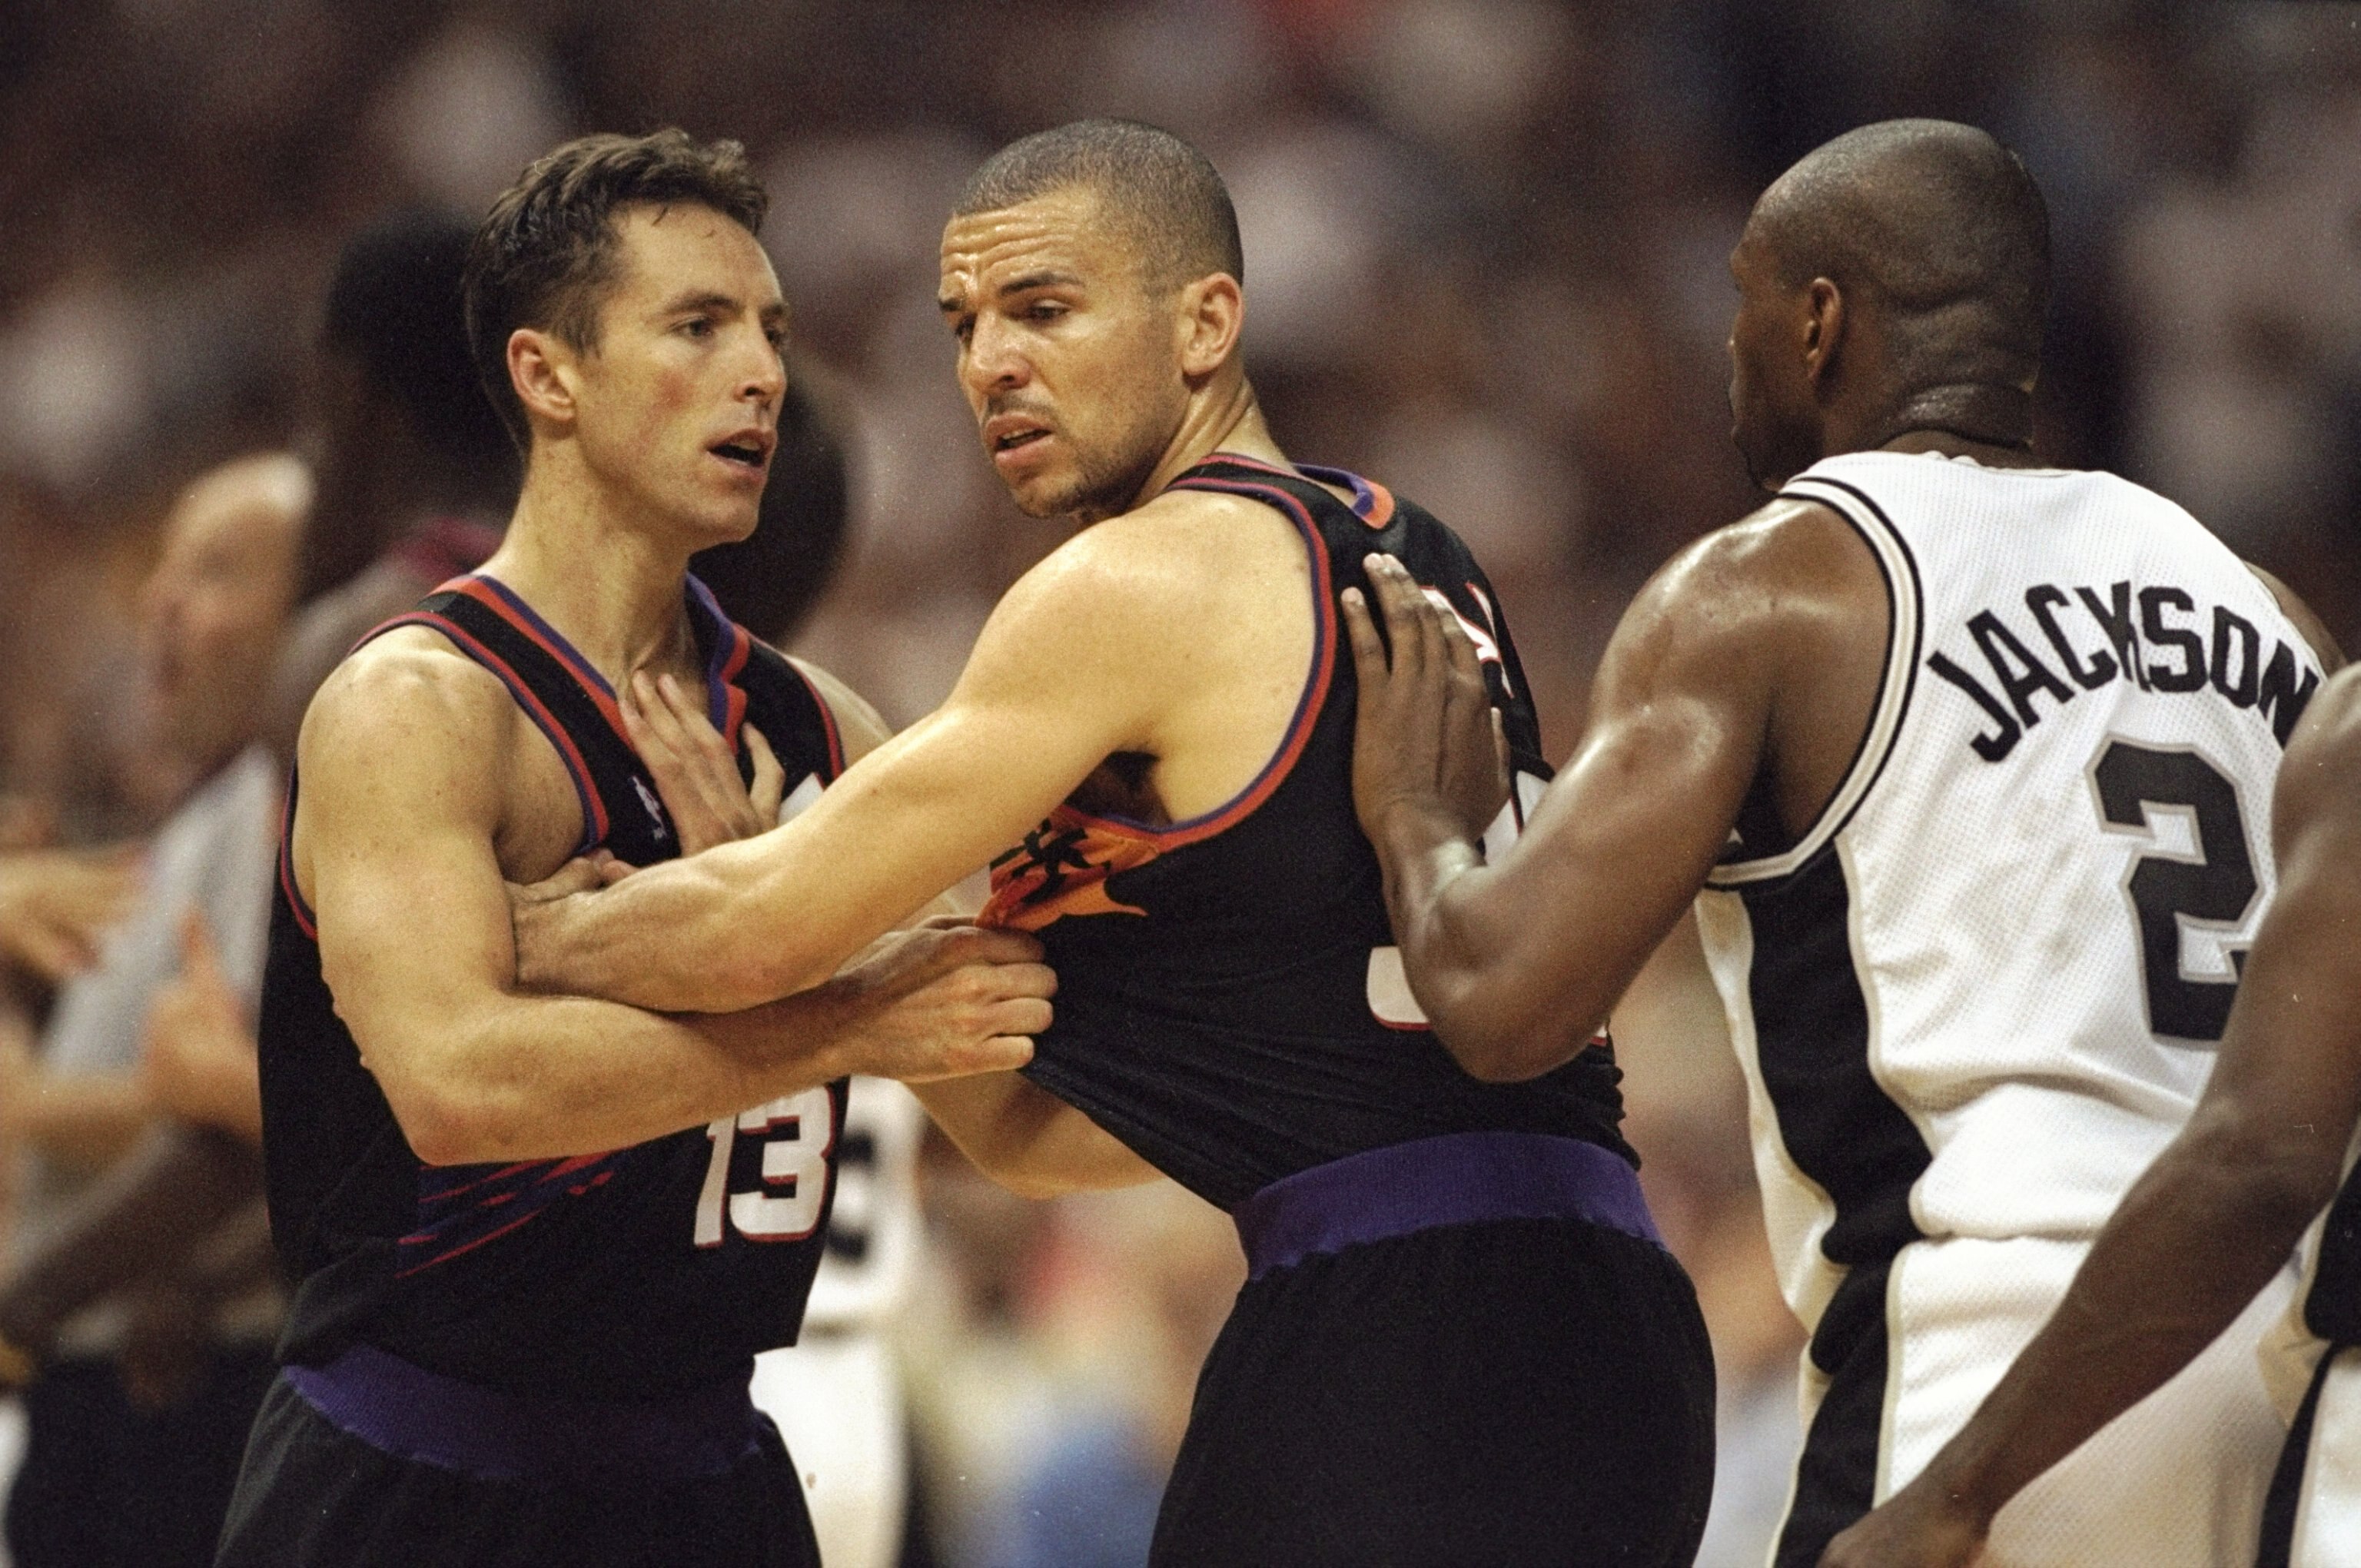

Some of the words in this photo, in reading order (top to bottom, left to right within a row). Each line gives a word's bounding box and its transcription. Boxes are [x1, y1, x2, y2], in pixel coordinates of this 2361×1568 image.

[1925, 580, 2319, 763] JACKSON
[2084, 732, 2264, 1052] 2
[694, 1085, 835, 1248] 13
